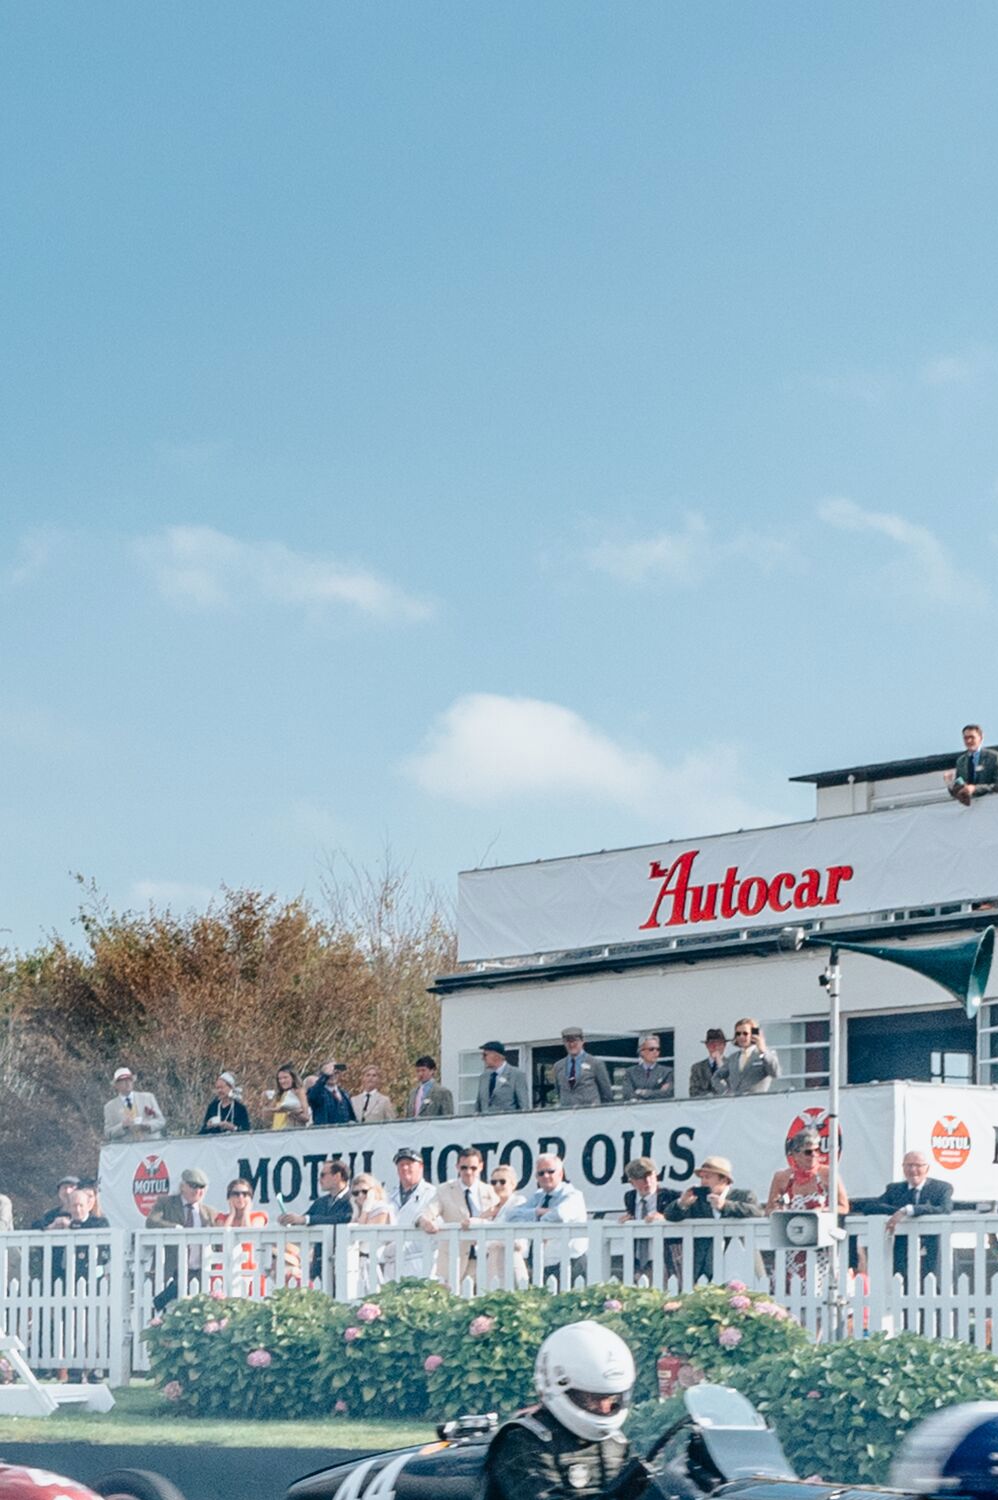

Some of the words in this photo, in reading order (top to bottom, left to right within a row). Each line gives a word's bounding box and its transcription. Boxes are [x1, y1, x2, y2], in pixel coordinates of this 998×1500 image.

[639, 850, 853, 930] Autocar
[582, 1126, 695, 1186] OILS
[931, 1136, 970, 1150] MOTUL
[134, 1178, 168, 1194] MOTUL
